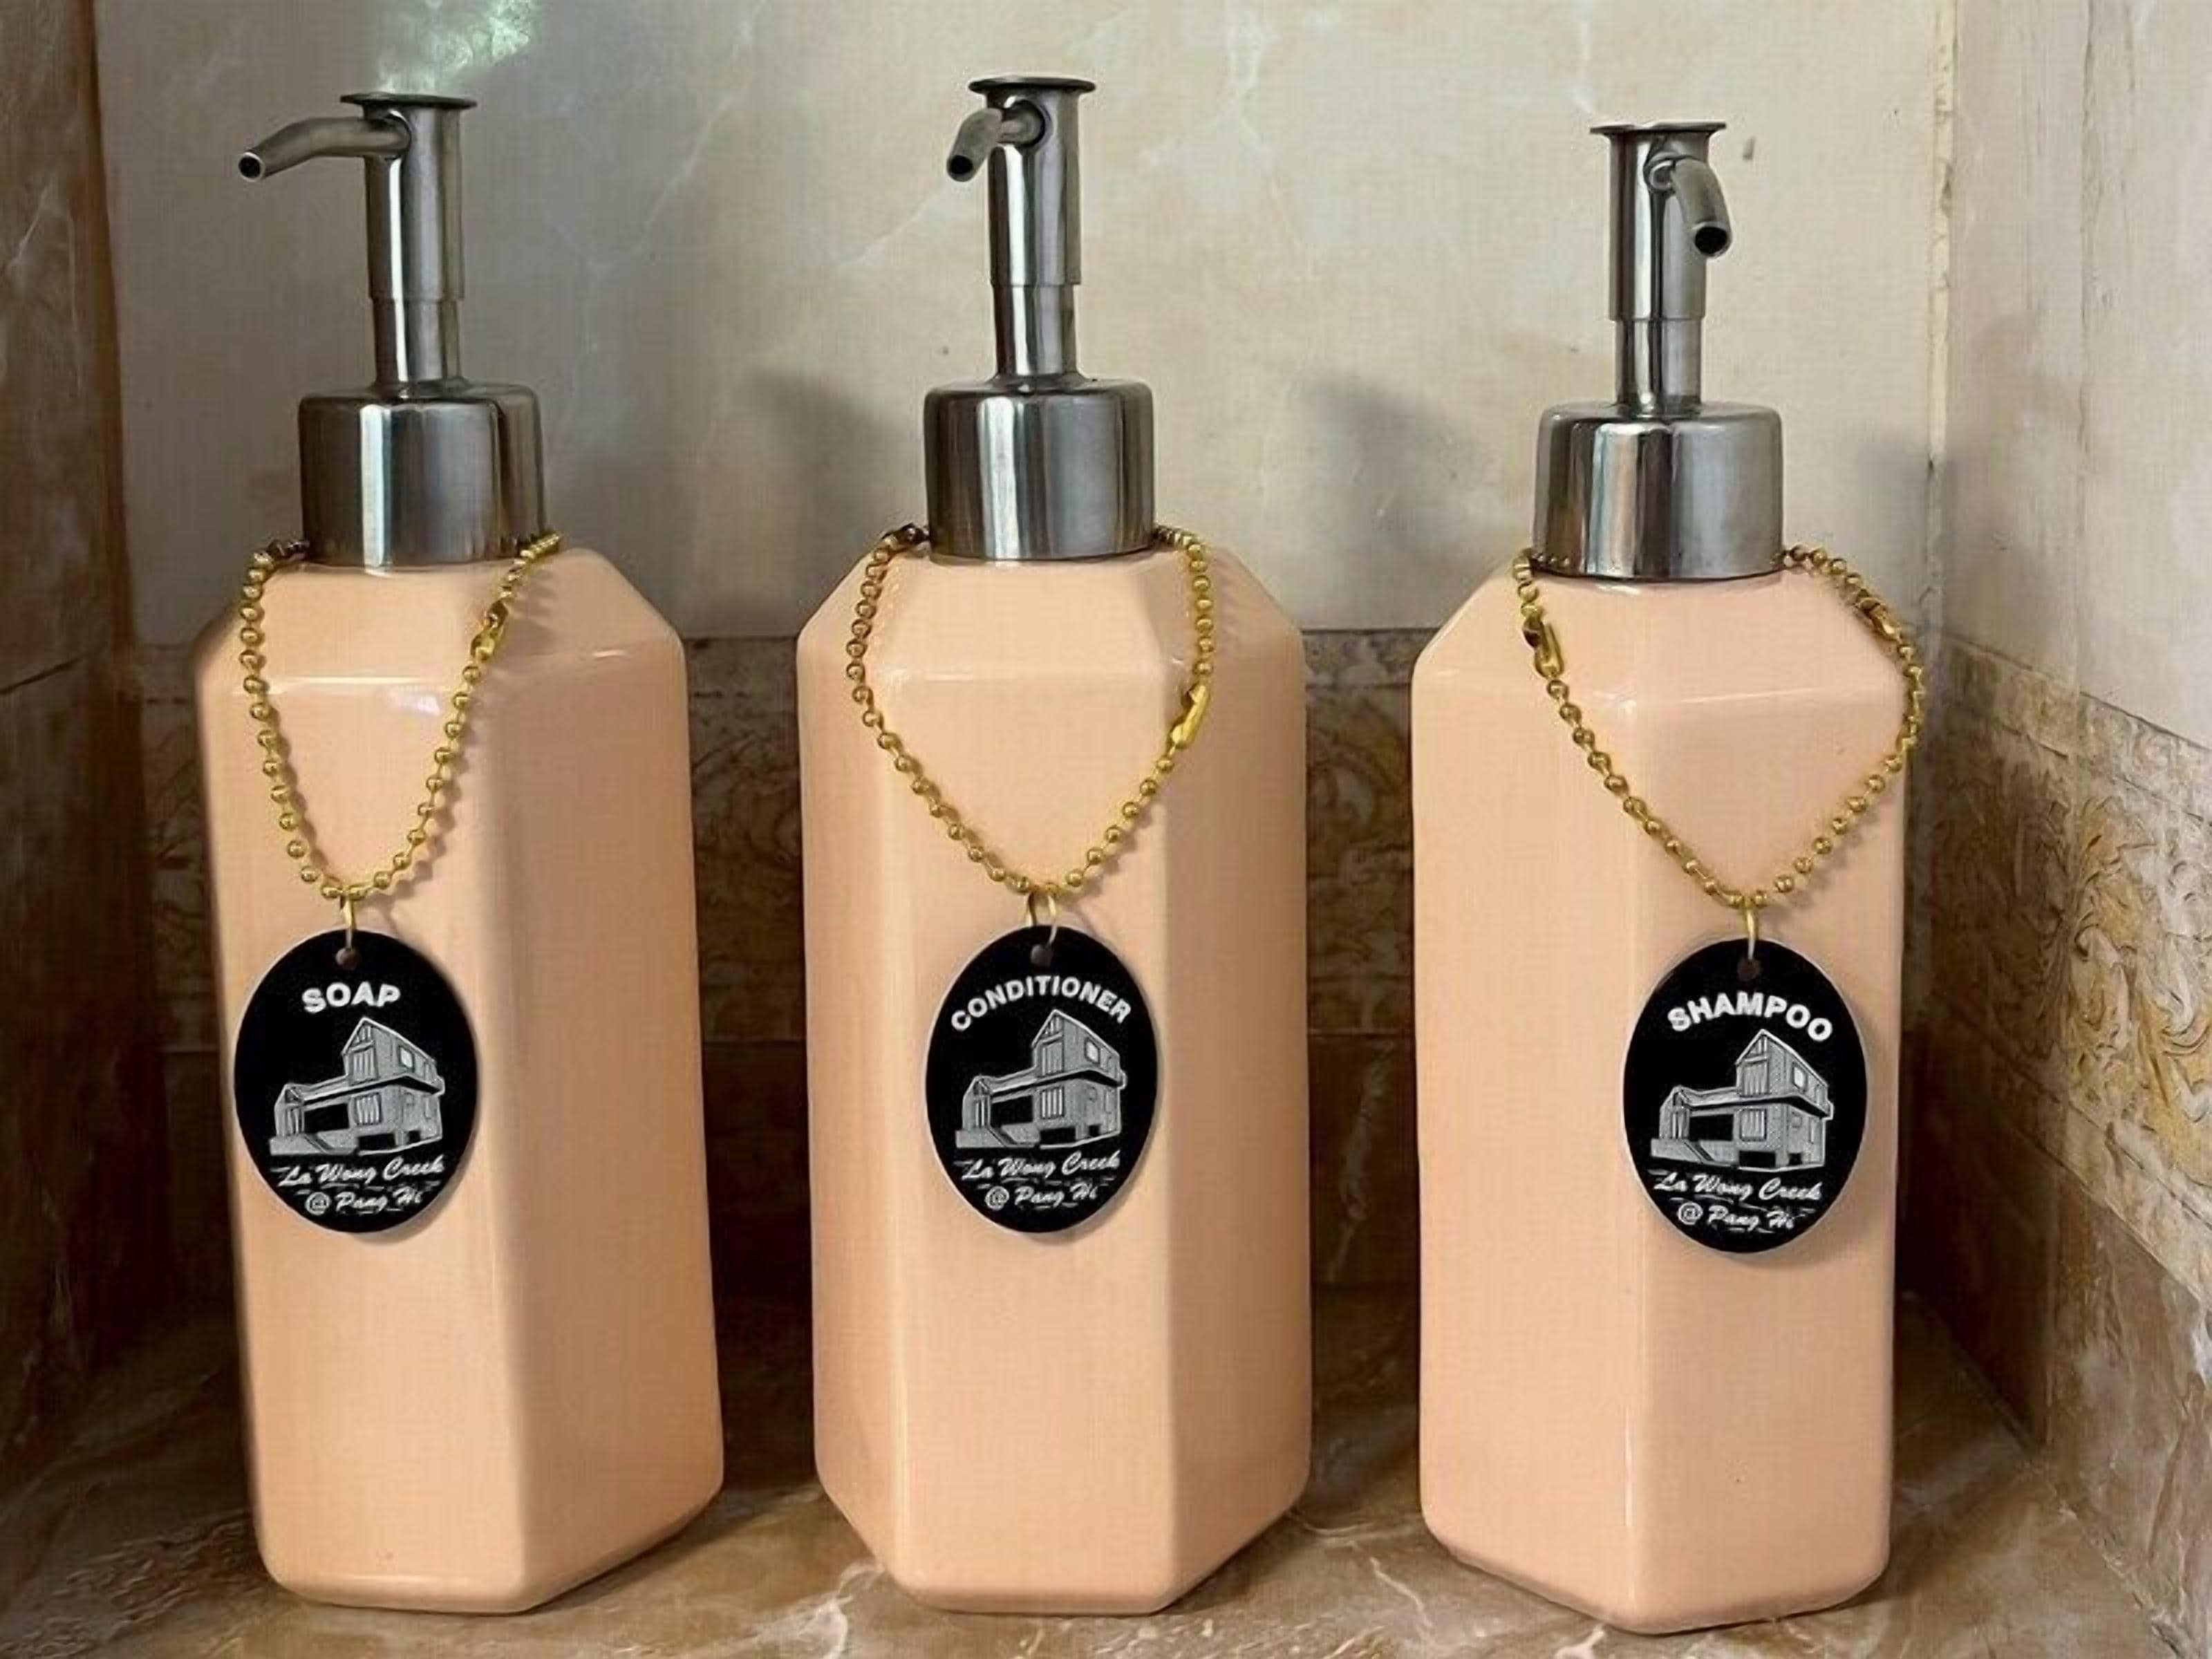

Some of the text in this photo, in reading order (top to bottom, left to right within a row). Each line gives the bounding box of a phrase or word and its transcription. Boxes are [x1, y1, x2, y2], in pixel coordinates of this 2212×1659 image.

[301, 982, 401, 1013] SOAP
[951, 975, 1132, 1031] CONDITIONER
[1667, 991, 1833, 1042] SHAMPOO
[383, 1154, 444, 1181] Creek
[1061, 1149, 1121, 1175] Creek
[984, 1186, 1010, 1210] @
[1759, 1177, 1823, 1201] Creek
[305, 1192, 330, 1215] @
[1677, 1201, 1704, 1226] @
